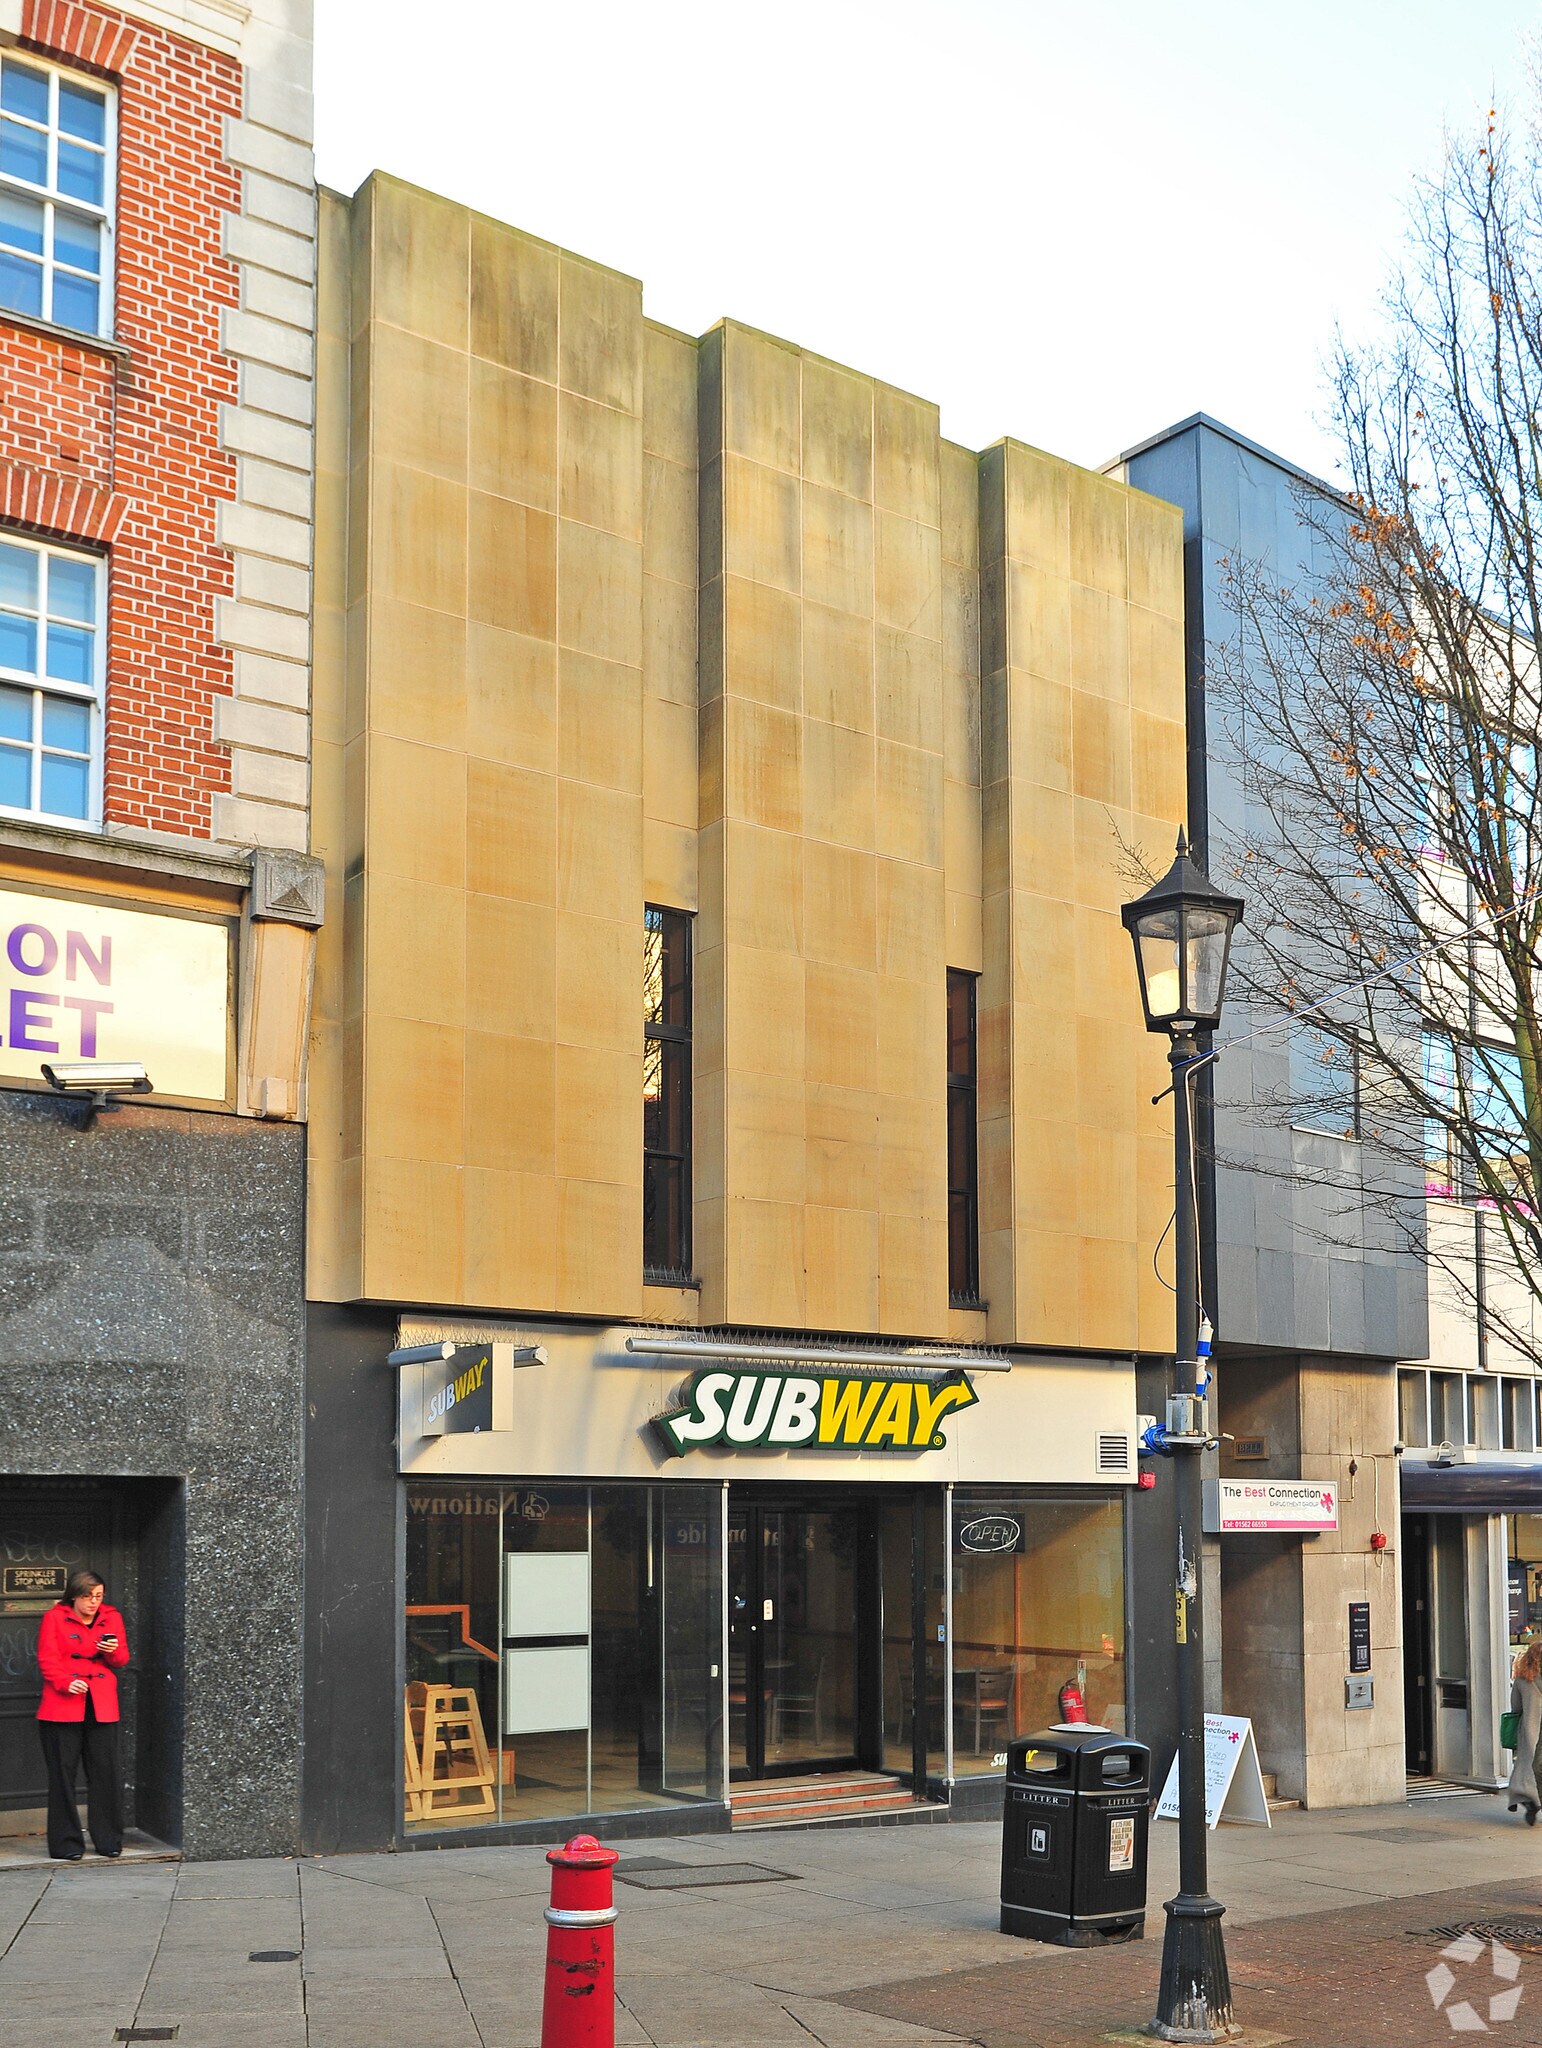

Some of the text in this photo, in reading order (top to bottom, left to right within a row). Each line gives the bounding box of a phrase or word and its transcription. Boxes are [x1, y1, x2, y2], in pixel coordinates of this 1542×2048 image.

[7, 923, 112, 986] ON
[0, 989, 114, 1058] ET
[428, 1356, 488, 1423] SUBWAY
[669, 1371, 973, 1446] SUBWAY
[1223, 1486, 1321, 1498] The Best Connection
[969, 1525, 1014, 1544] OPEN
[1205, 1719, 1223, 1727] Best
[1023, 1793, 1059, 1804] LITTER
[1108, 1797, 1135, 1806] LITTER
